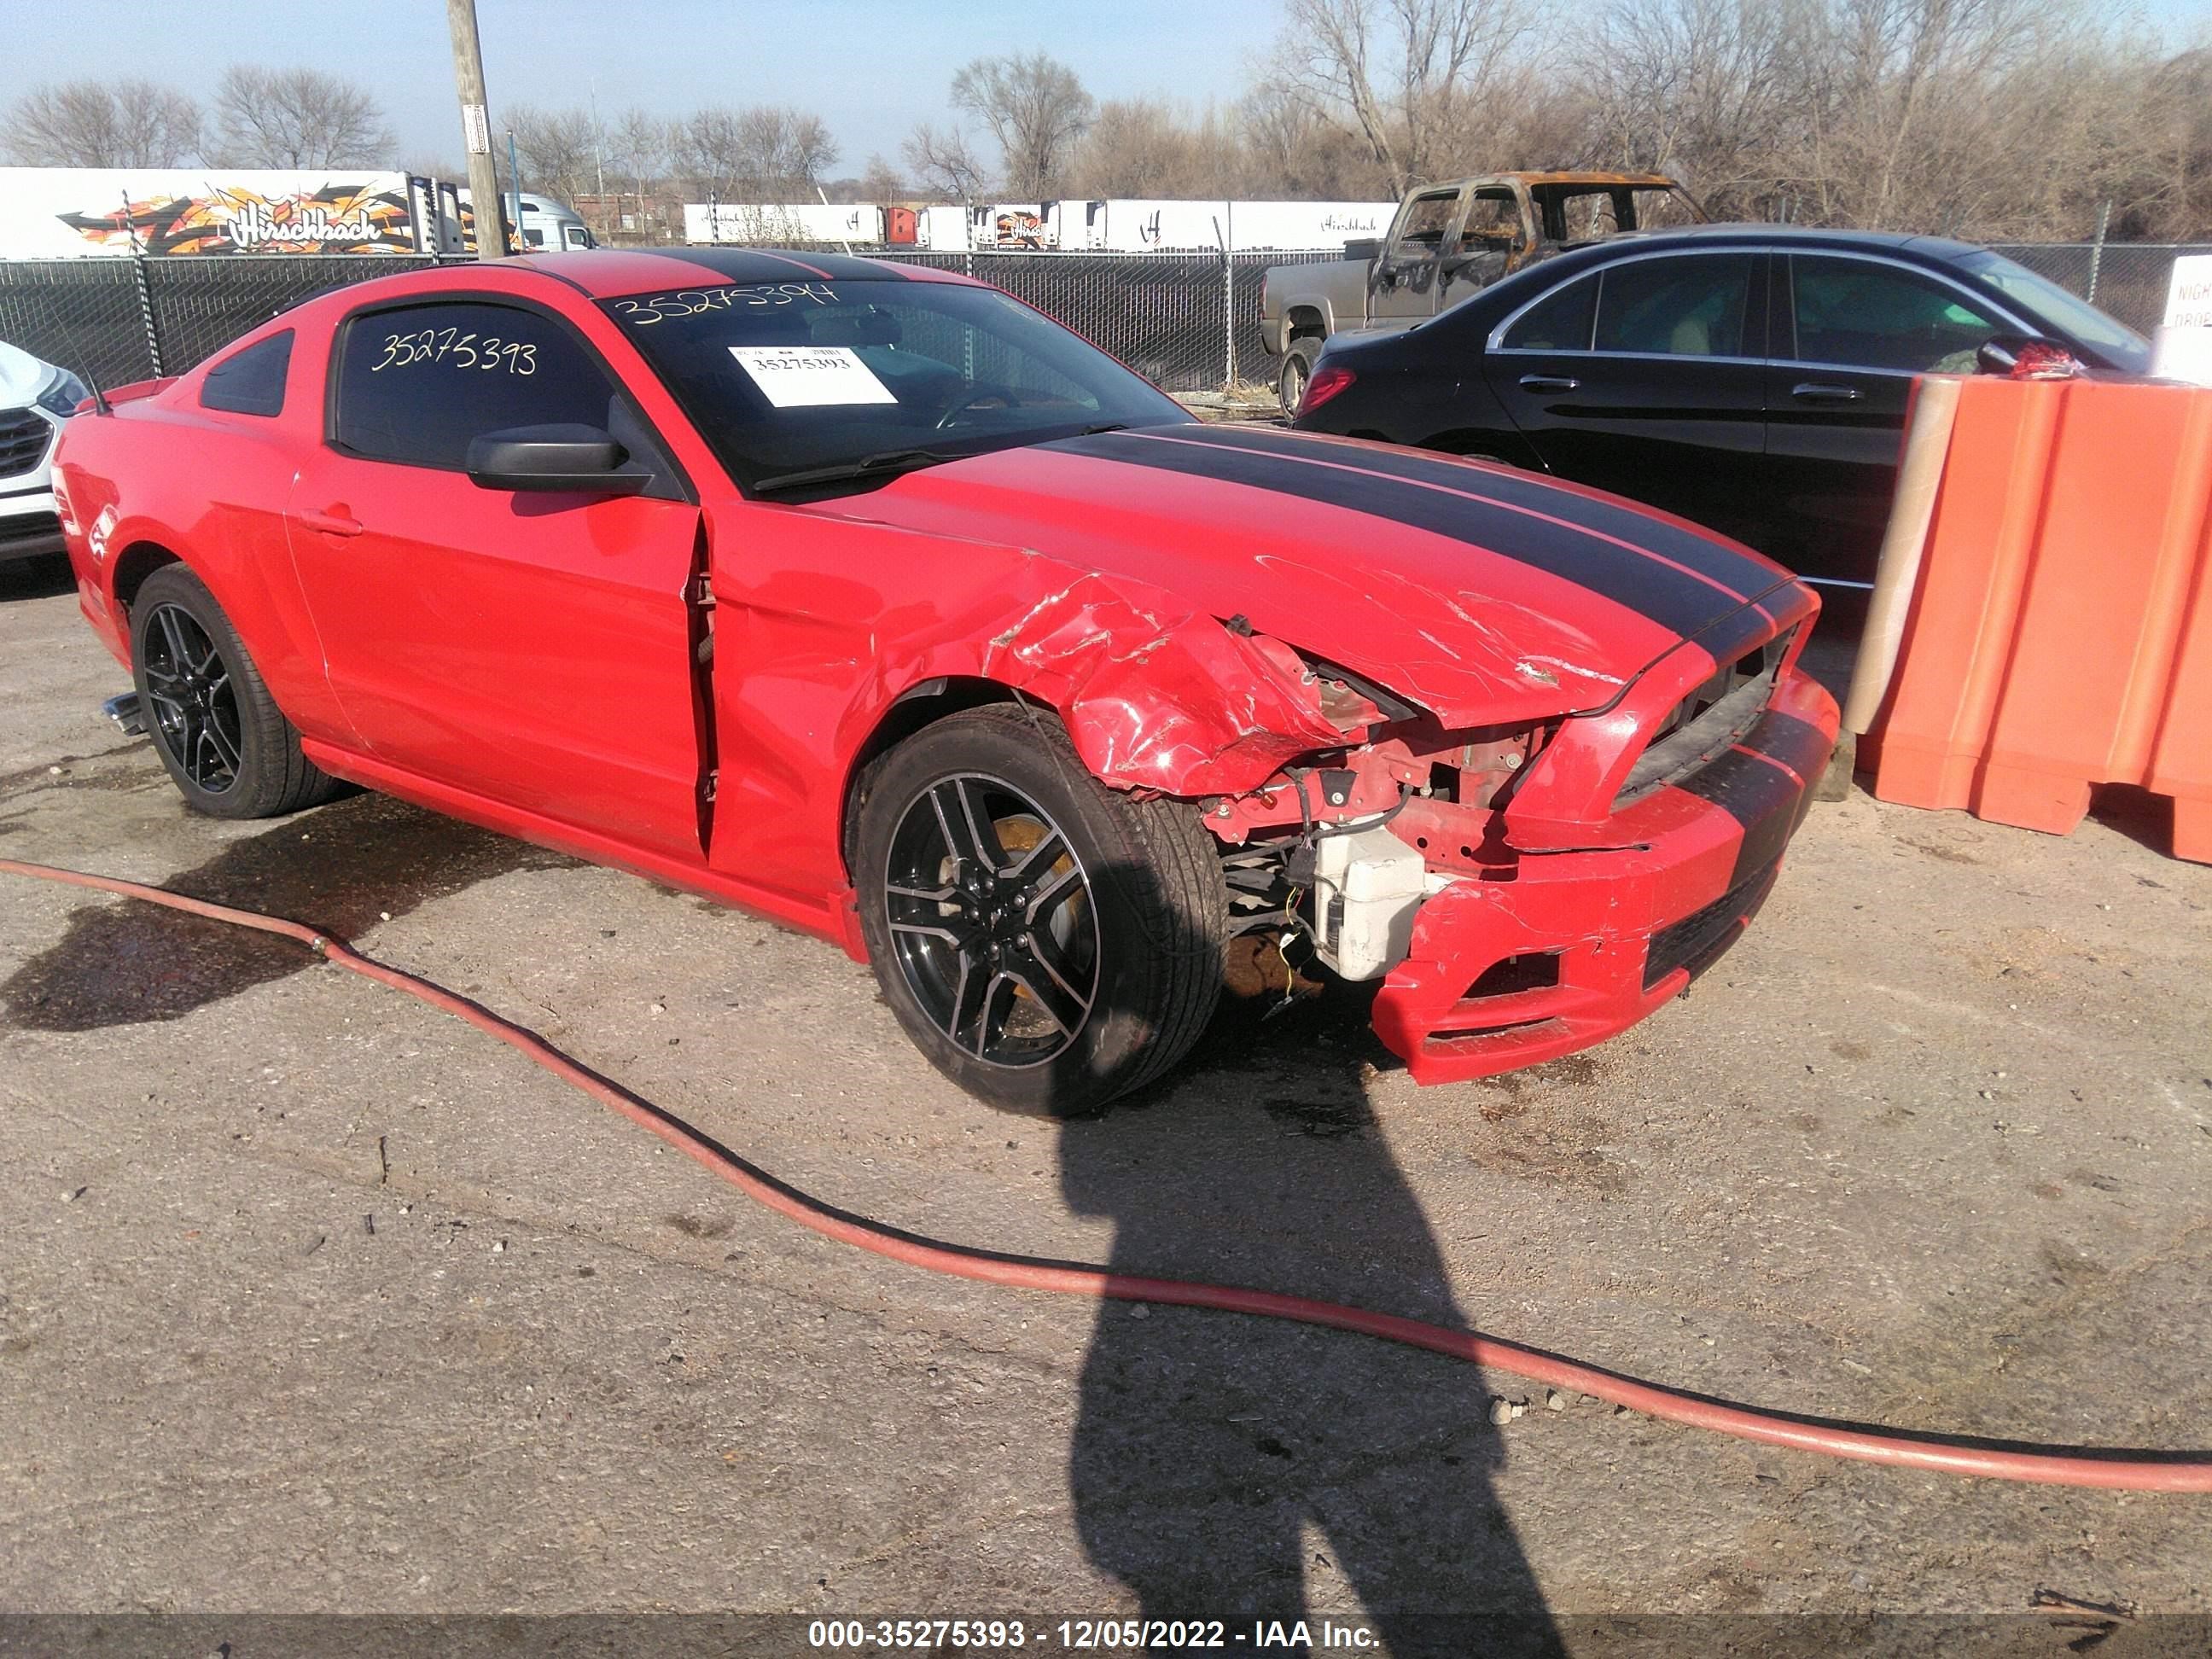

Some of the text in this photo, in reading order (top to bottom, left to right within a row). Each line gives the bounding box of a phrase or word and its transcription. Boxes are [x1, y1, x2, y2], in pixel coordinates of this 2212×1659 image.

[227, 199, 382, 247] Hirschbach
[371, 328, 537, 375] 35275393
[753, 358, 851, 370] 35275393
